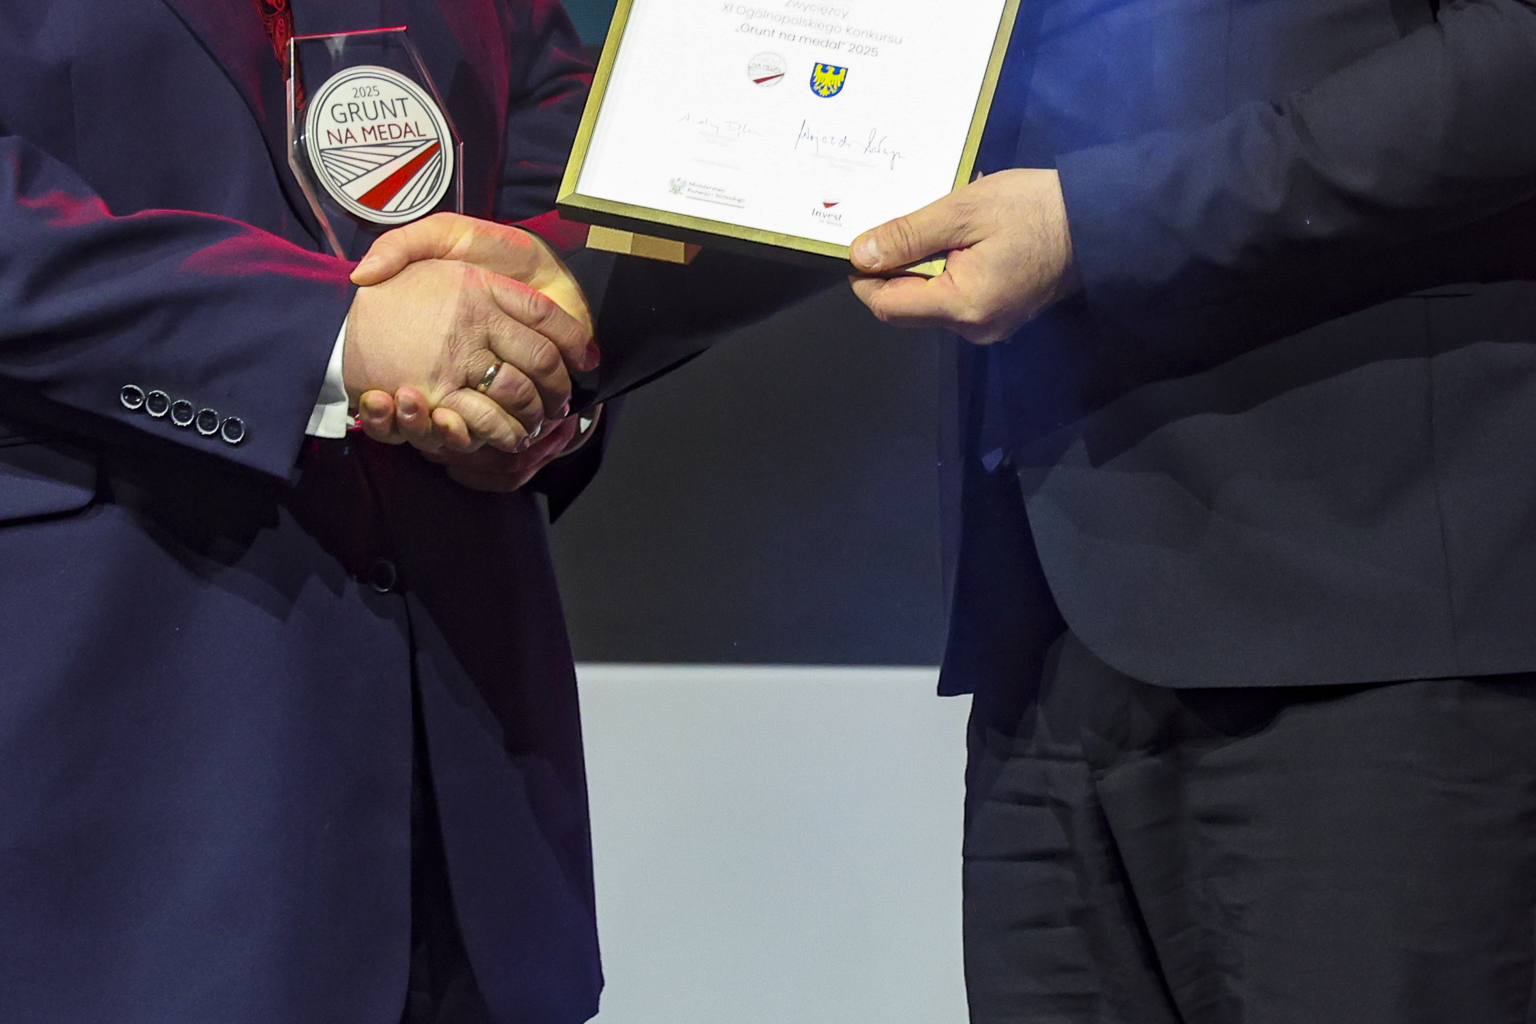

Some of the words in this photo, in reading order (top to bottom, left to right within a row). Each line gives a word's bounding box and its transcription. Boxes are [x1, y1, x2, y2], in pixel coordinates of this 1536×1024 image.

[721, 2, 734, 14] XI
[735, 4, 843, 35] Ogólnopolskiego
[844, 25, 904, 46] Konkursu
[778, 31, 797, 43] na
[847, 42, 880, 59] 2025
[352, 85, 381, 99] 2025
[330, 97, 409, 124] GRUNT
[326, 127, 358, 146] NA
[361, 121, 427, 143] MEDAL
